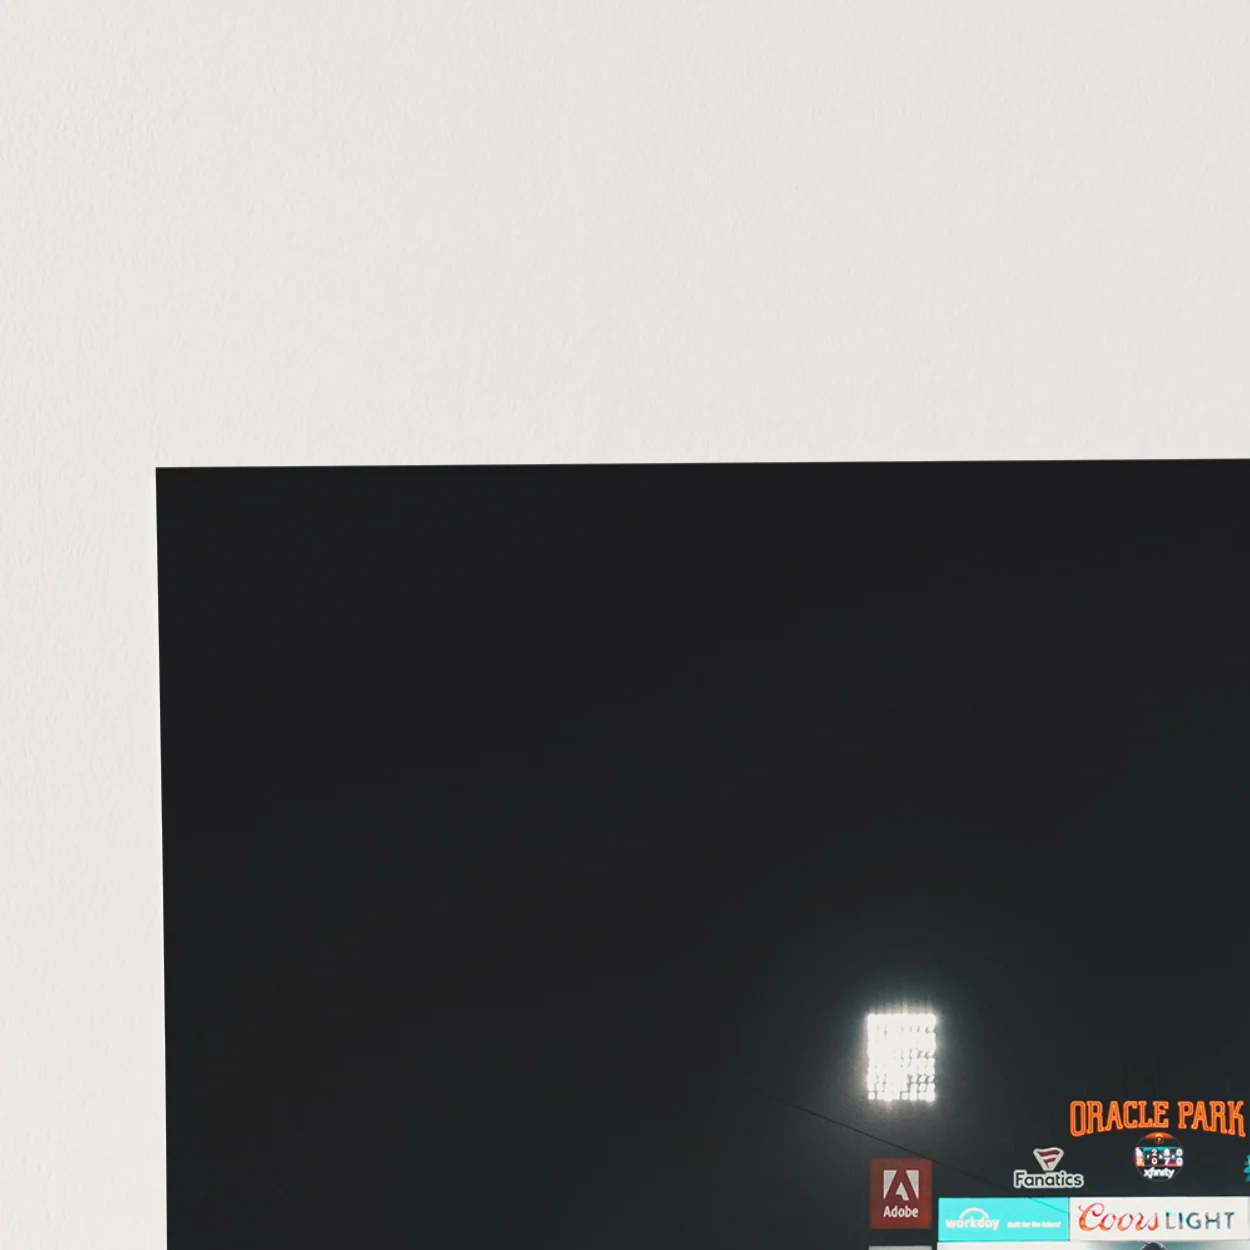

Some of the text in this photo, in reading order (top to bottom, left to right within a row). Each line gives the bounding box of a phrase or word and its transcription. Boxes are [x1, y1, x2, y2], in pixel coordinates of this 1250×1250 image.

[1069, 1100, 1246, 1138] ORACLE PARK
[1013, 1169, 1085, 1188] Fanatics
[882, 1205, 919, 1218] Adobe
[1077, 1202, 1236, 1233] Coors LIGHT
[945, 1216, 1000, 1231] workday
